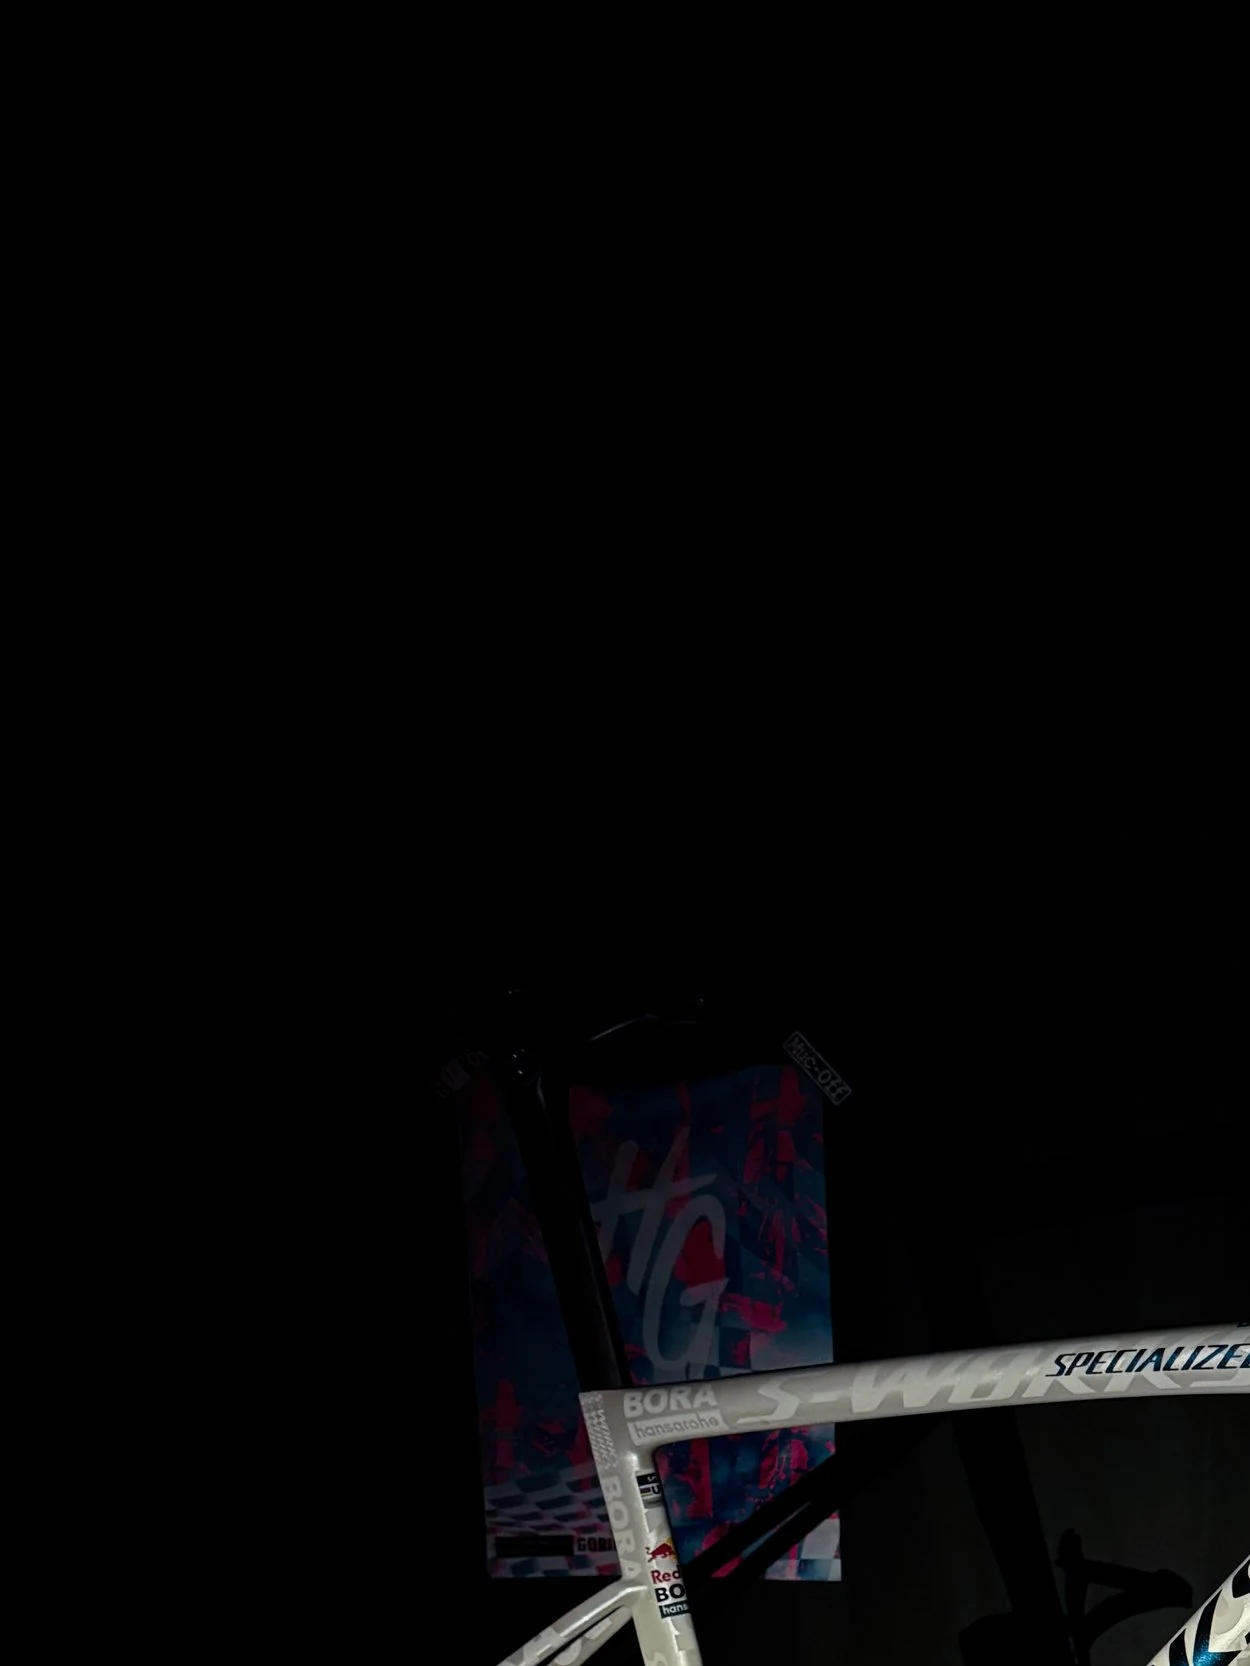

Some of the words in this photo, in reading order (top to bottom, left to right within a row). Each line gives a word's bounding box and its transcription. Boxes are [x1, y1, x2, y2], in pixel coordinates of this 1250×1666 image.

[623, 1386, 719, 1418] BORA
[577, 1537, 616, 1551] GOBI
[603, 1476, 641, 1581] BORA
